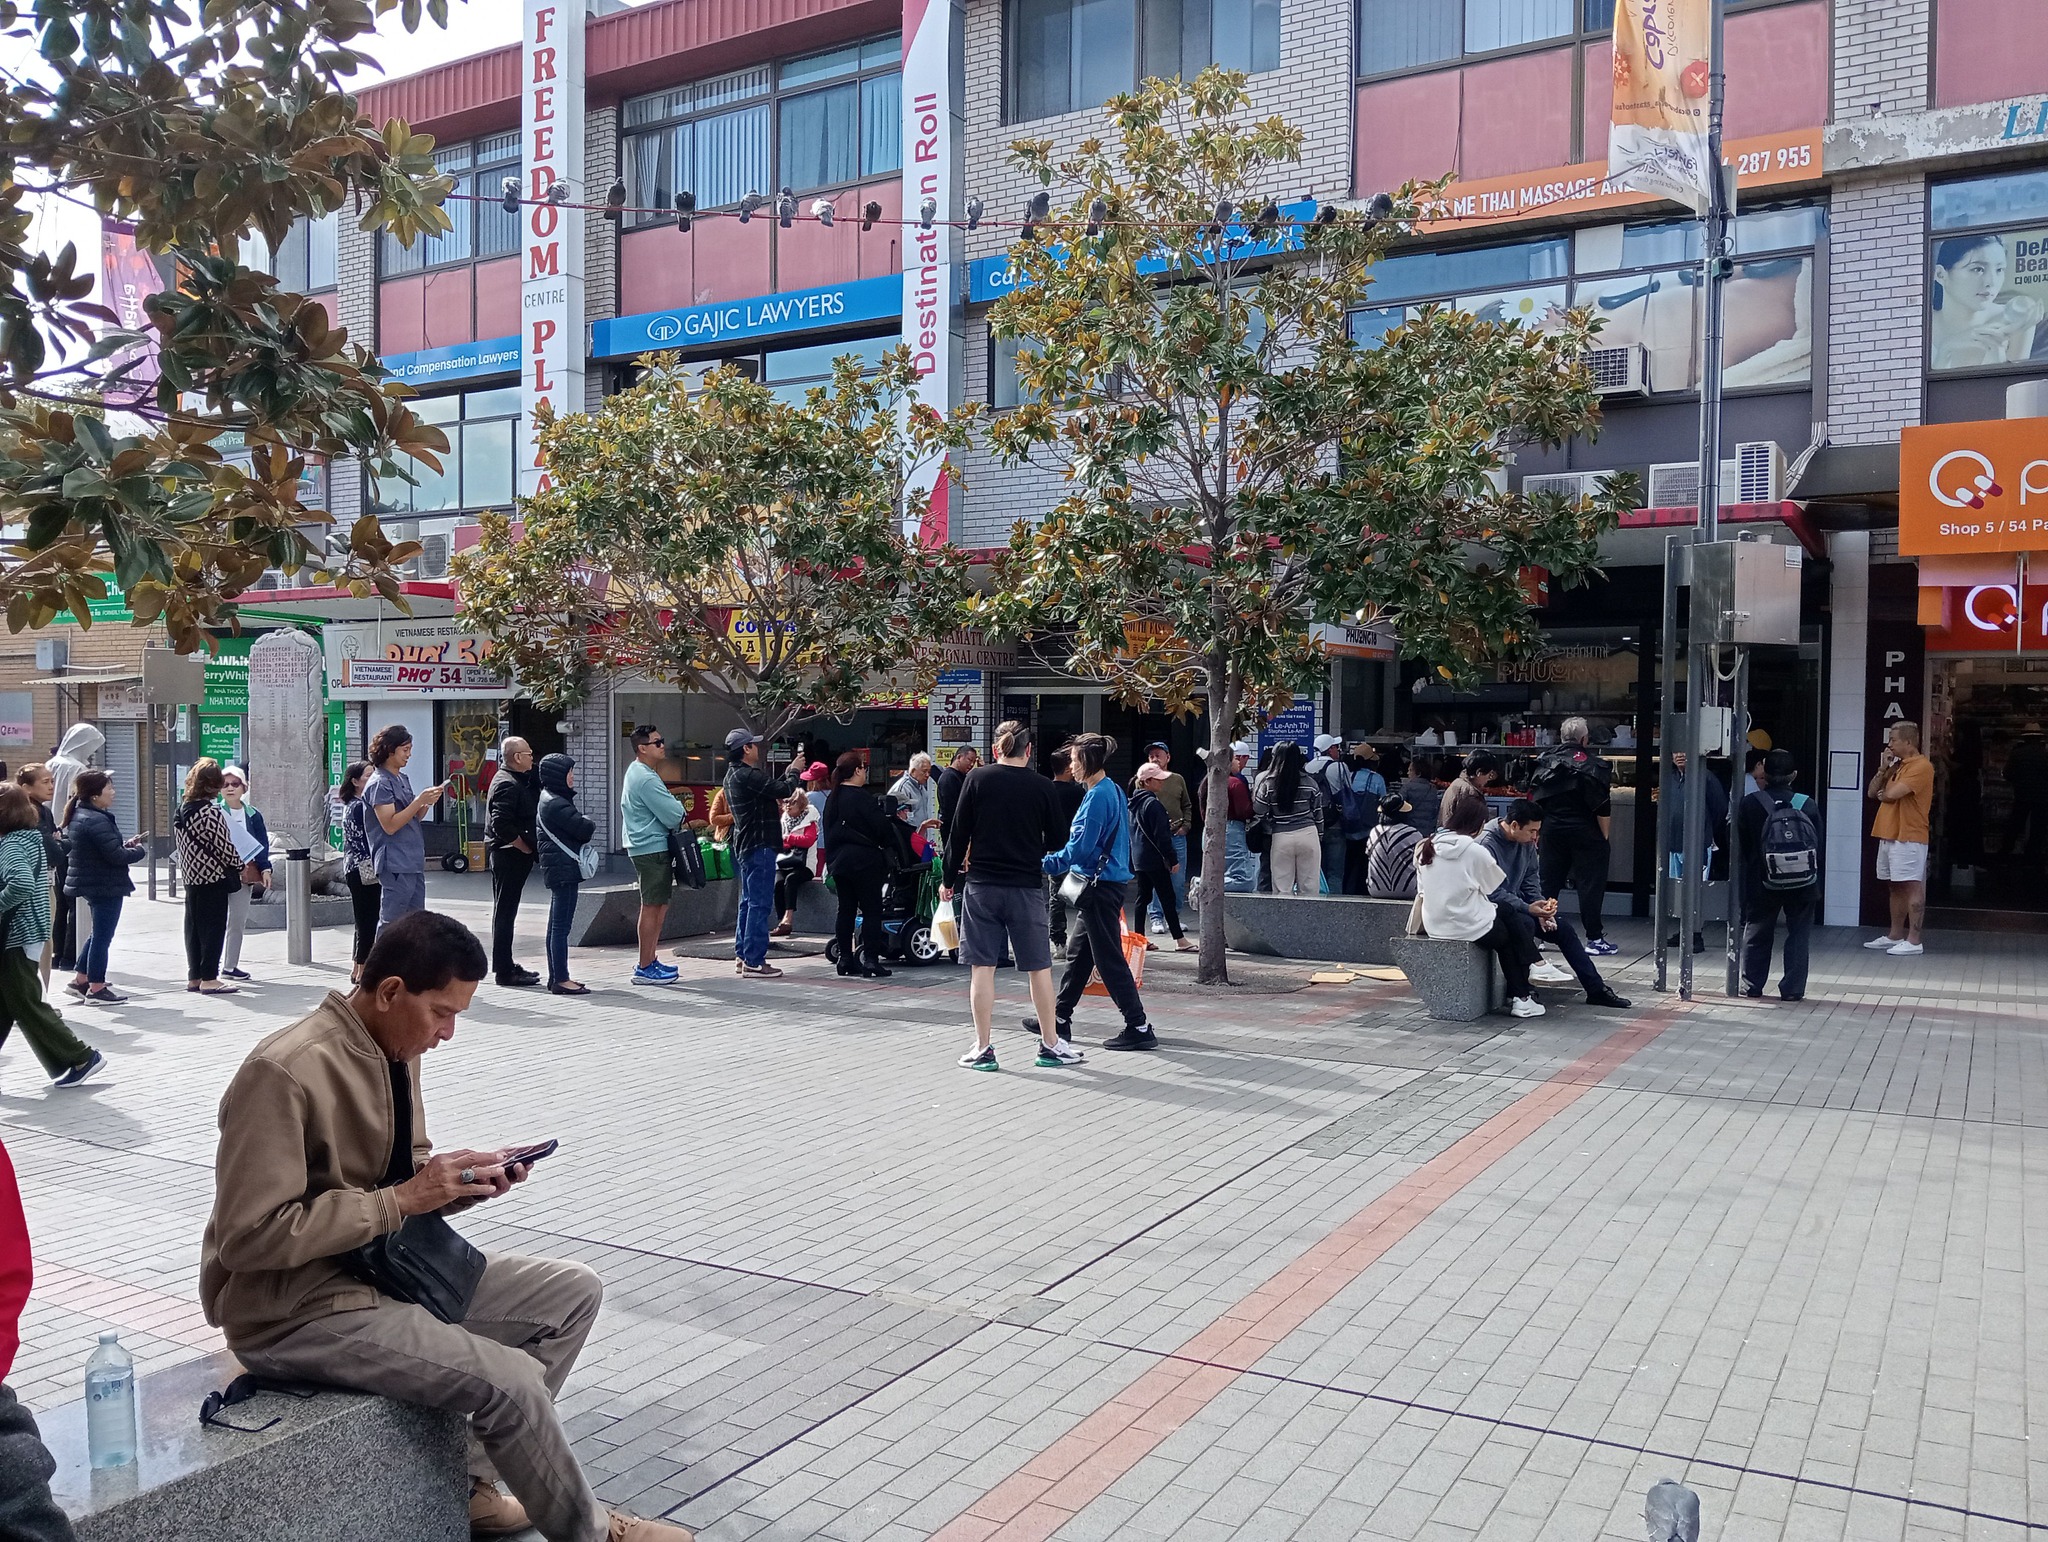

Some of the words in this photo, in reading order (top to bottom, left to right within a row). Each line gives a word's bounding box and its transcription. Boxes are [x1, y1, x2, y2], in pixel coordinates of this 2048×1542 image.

[914, 93, 938, 163] Roll
[529, 7, 559, 279] FREEDOM
[1738, 150, 1770, 176] 287
[1777, 144, 1811, 169] 955
[1453, 196, 1475, 217] ME
[1480, 189, 1515, 213] THAI
[1520, 178, 1596, 208] MASSAGE
[914, 173, 938, 375] Destinatn
[524, 288, 565, 308] CENTRE
[684, 308, 740, 338] GAJIC
[746, 291, 844, 327] LAWYERS
[406, 355, 477, 376] Compensation
[478, 349, 519, 367] Lawyers
[1940, 523, 1980, 537] Shop
[1985, 521, 1995, 533] 5
[1998, 521, 2005, 533] /
[2008, 520, 2027, 532] 54
[395, 627, 435, 637] VIETNAMESE
[977, 650, 1015, 667] CENTRE
[204, 670, 249, 682] erryWhit
[440, 668, 462, 684] 54
[944, 694, 972, 714] 54
[933, 715, 960, 725] PARK
[964, 715, 979, 725] RD
[332, 723, 342, 850] PHRCY
